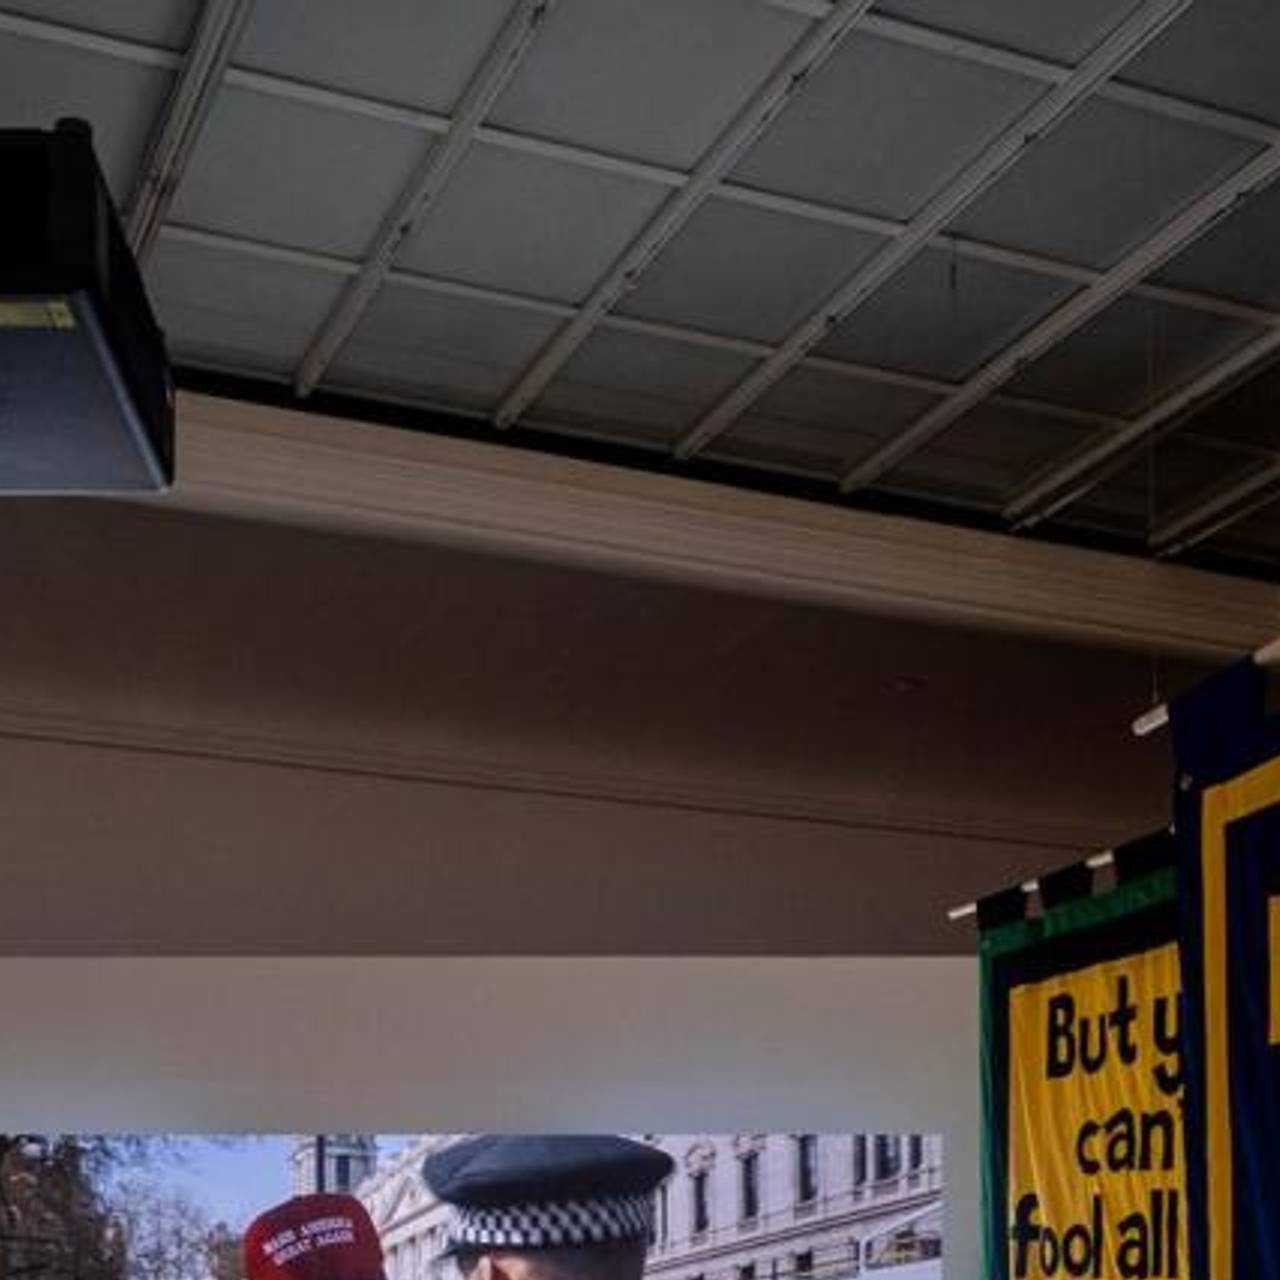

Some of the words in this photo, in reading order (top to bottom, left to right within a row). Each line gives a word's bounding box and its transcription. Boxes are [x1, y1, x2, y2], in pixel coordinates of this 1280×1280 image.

[1046, 976, 1137, 1080] But
[1008, 1192, 1103, 1280] fool
[1116, 1188, 1179, 1280] all
